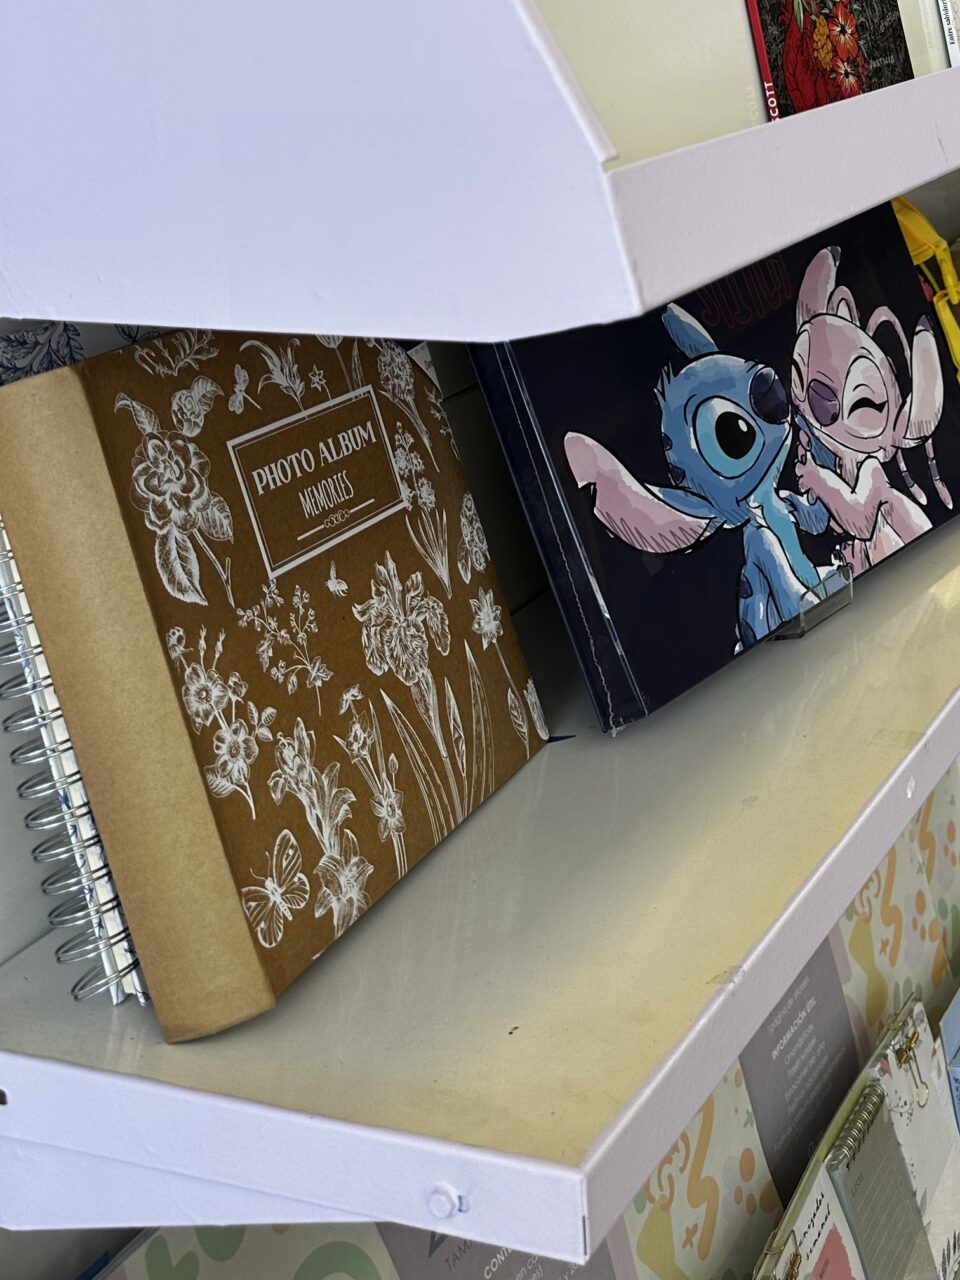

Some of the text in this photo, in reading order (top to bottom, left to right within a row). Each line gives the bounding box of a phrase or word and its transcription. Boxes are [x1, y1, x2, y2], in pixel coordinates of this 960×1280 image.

[947, 26, 956, 46] Entre
[251, 420, 378, 497] PHOTO ALBUM
[298, 469, 355, 520] MEMORIES
